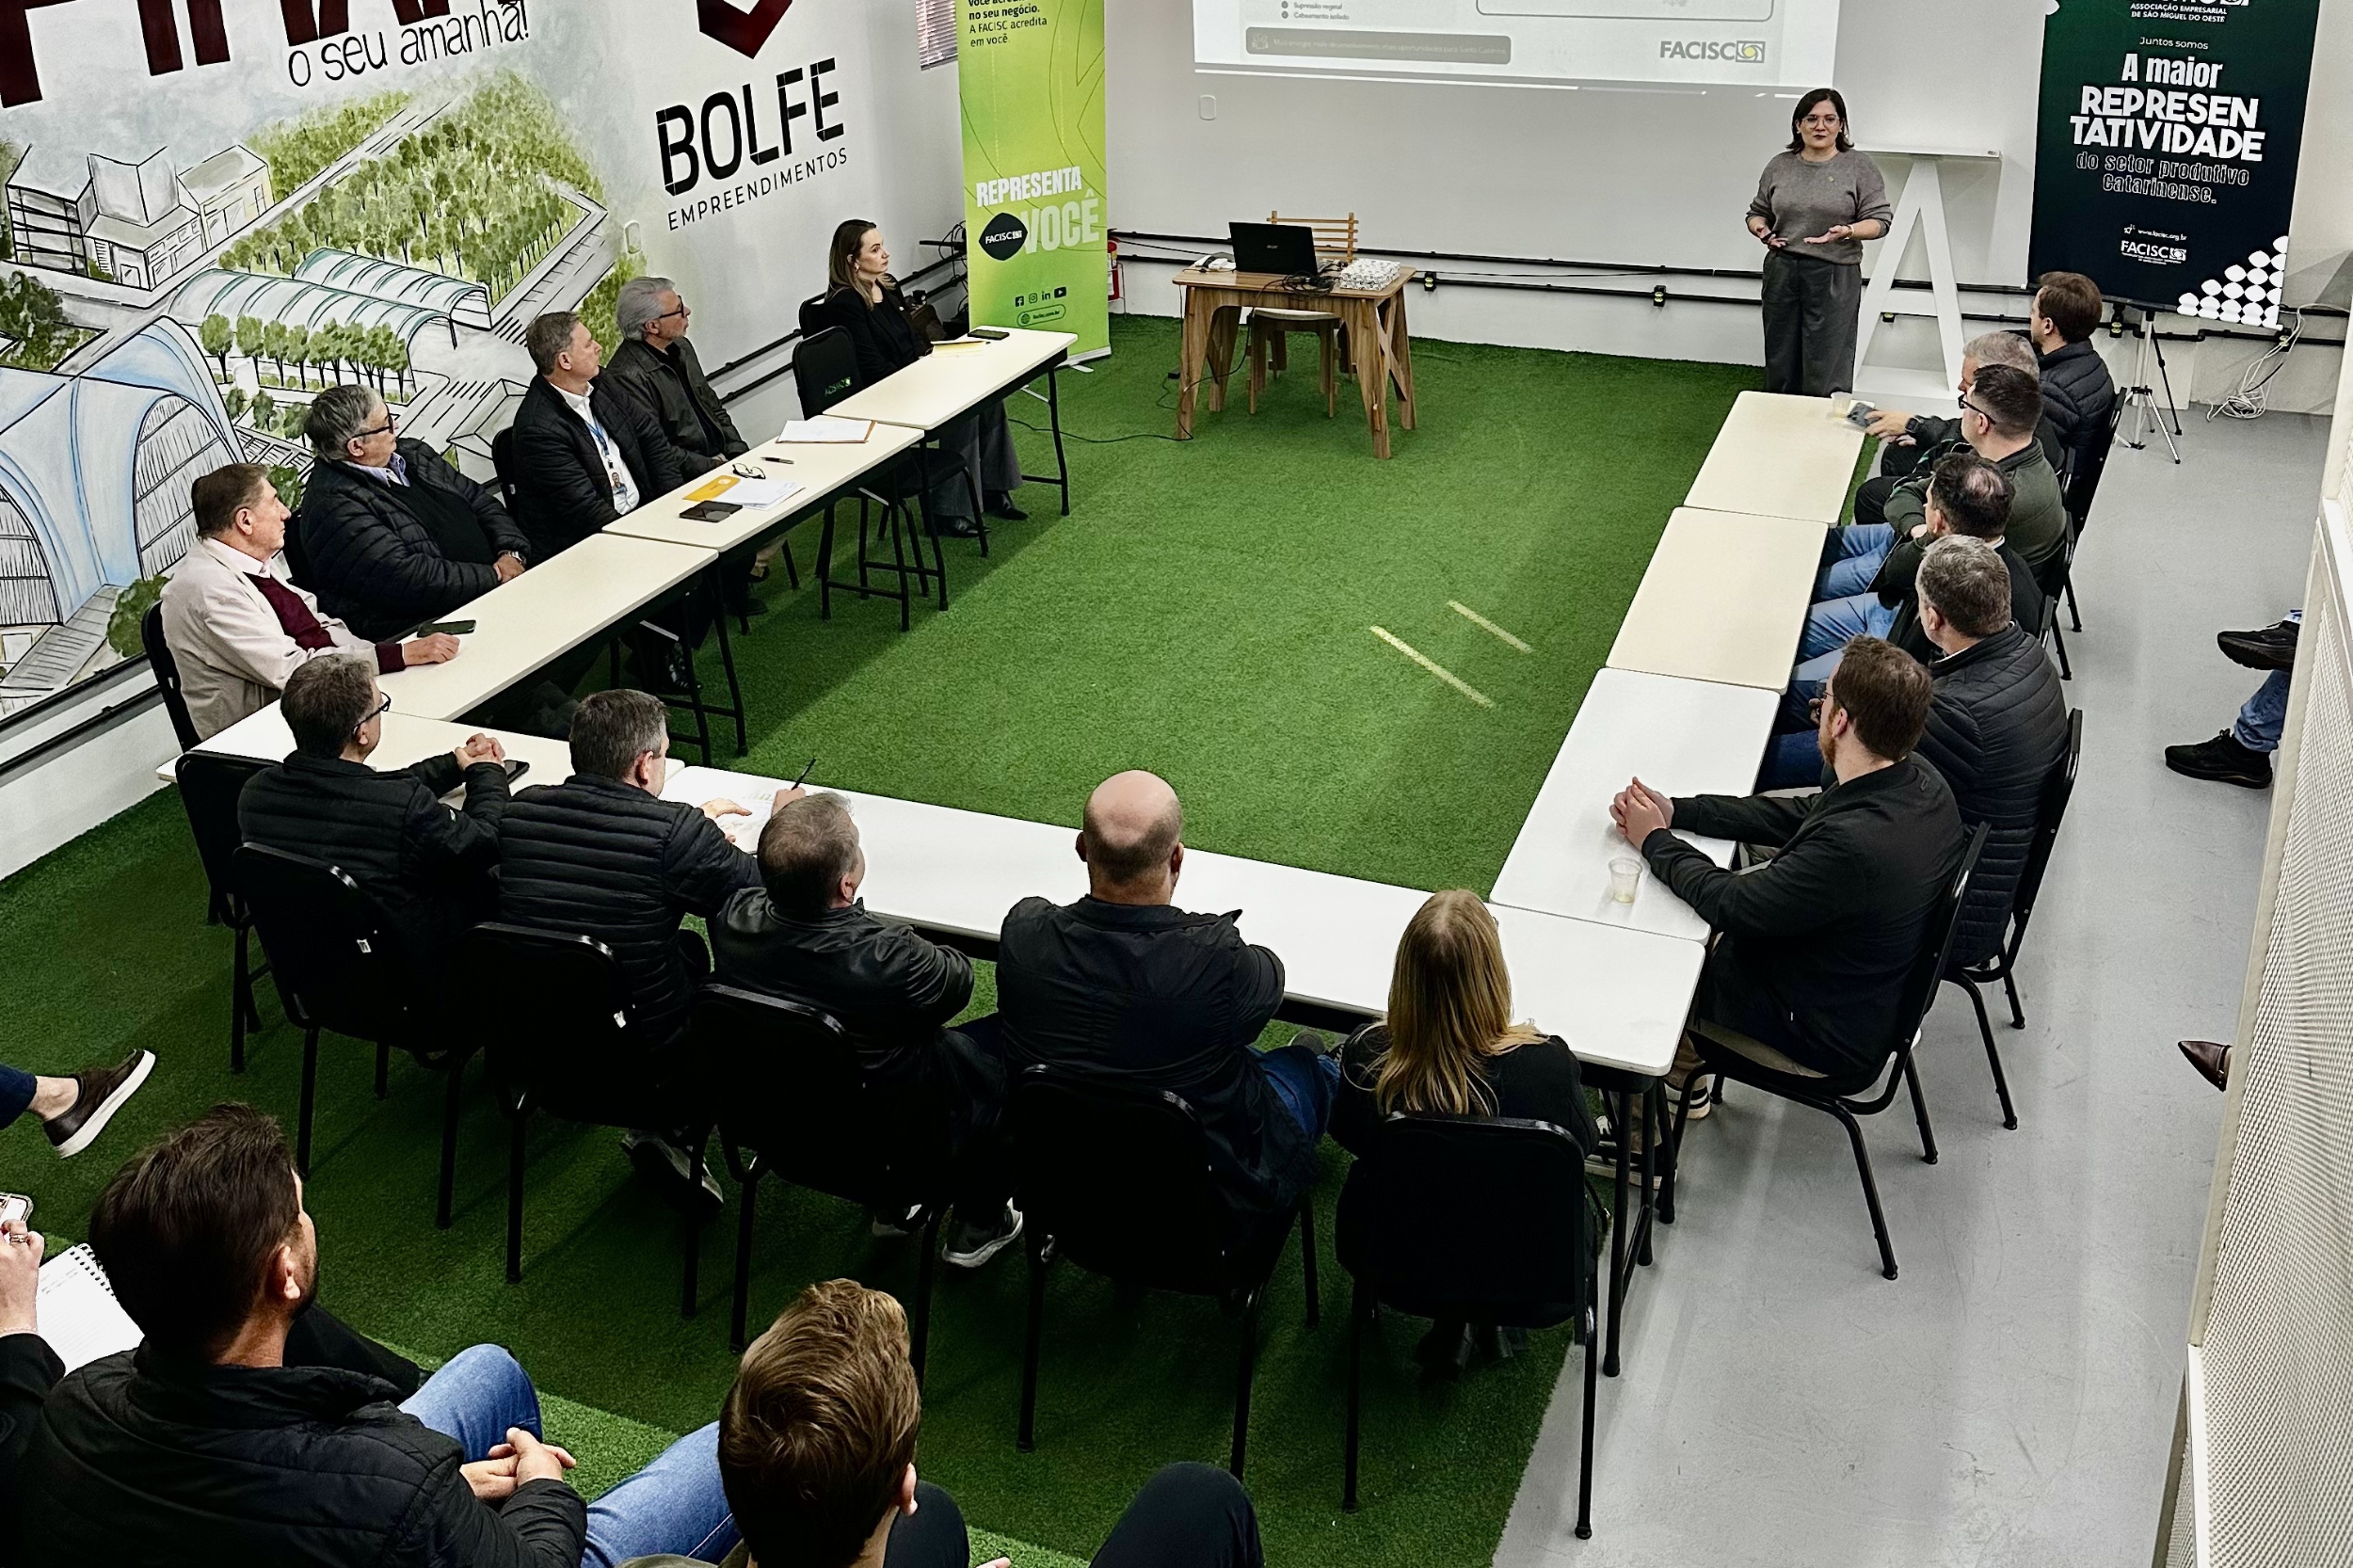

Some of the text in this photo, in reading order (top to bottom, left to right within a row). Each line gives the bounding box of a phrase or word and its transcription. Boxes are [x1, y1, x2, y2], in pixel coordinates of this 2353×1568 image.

[968, 3, 1040, 21] no seu negócio.
[2130, 3, 2228, 15] ASSOCIAÇÃO EMPRESARIAL
[2160, 12, 2187, 21] MIGUEL
[969, 17, 1048, 34] A FACISC acredita
[288, 50, 312, 87] o
[320, 31, 388, 81] seu
[400, 0, 529, 65] amanhã!
[970, 37, 984, 47] em
[1659, 40, 1736, 61] FACISC
[2139, 37, 2209, 50] Juntos somos
[2121, 53, 2223, 88] A maior
[2080, 85, 2259, 129] REPRESEN
[655, 57, 844, 197] BOLFE
[2070, 115, 2265, 162] TATIVIDADE
[2075, 151, 2249, 186] do setor produtivo
[667, 147, 847, 232] EMPREENDIMENTOS
[975, 166, 1082, 208] REPRESENTA
[2103, 173, 2217, 204] Catarinense.
[1020, 188, 1099, 255] VOCÊ
[984, 232, 1014, 245] FACISC
[2121, 240, 2169, 259] FACISC
